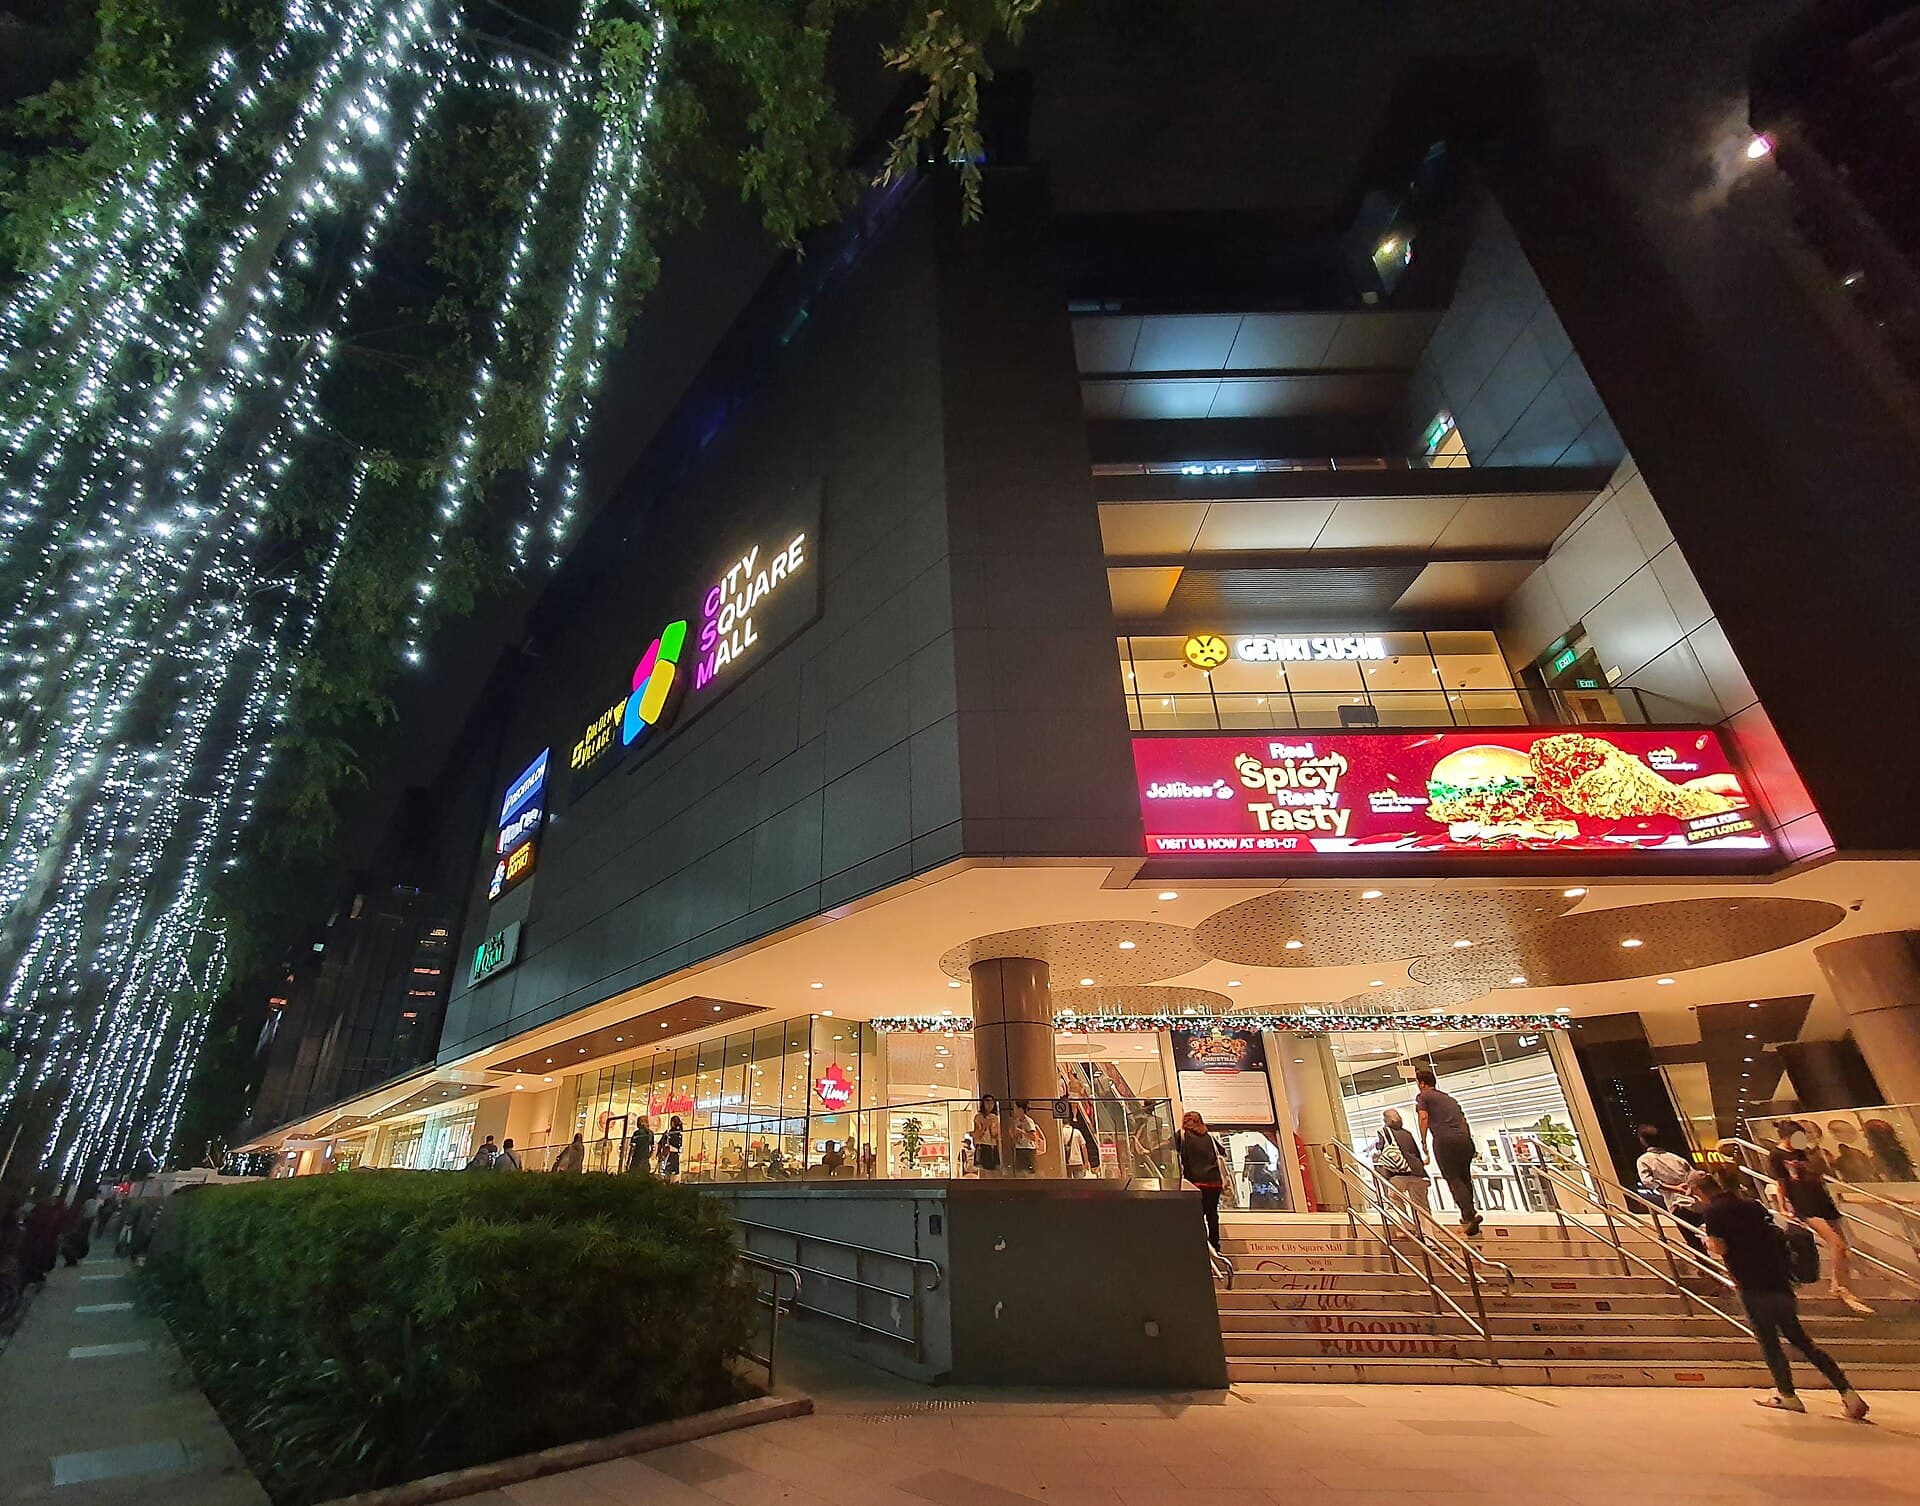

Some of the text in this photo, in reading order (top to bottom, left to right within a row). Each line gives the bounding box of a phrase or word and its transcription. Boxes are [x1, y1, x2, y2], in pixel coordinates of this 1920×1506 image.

[700, 532, 806, 651] SQUARE
[704, 544, 759, 617] CITY
[696, 616, 758, 690] MALL
[1237, 637, 1386, 662] GENKI SUSHI
[585, 706, 614, 745] GOLDEN
[581, 727, 610, 768] VILLAGE
[1269, 743, 1315, 760] Real
[1146, 783, 1214, 799] Jollibee
[1239, 757, 1341, 795] Spicy
[1277, 789, 1341, 808] Really
[1247, 802, 1351, 837] Tasty
[1157, 838, 1187, 850] VISIT
[1189, 838, 1206, 849] US
[1207, 838, 1238, 849] NOW
[1240, 838, 1255, 849] AT
[820, 1079, 849, 1102] Tims
[1250, 1242, 1343, 1253] The new City Square Mall
